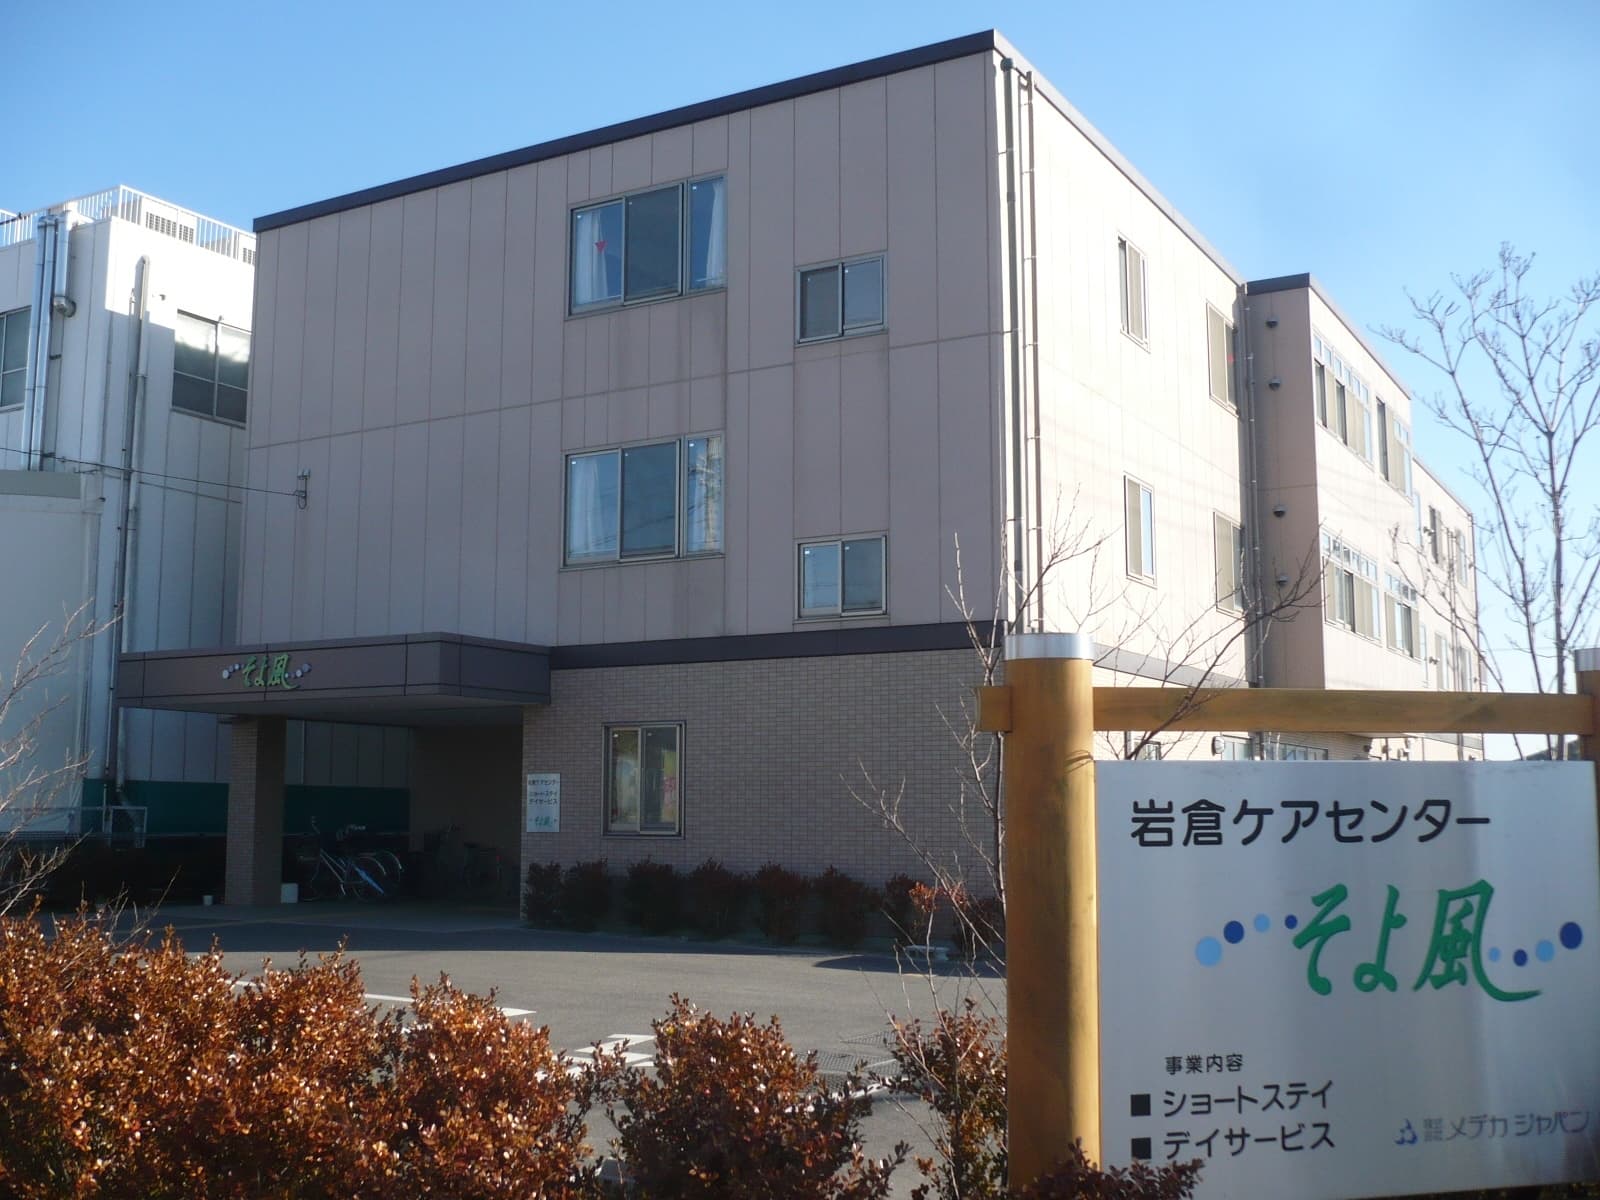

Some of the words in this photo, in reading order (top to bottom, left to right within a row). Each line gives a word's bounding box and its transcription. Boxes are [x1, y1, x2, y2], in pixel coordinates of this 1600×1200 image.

[242, 652, 301, 689] そよ風
[1131, 799, 1491, 848] 岩倉ケアセンター
[1293, 879, 1543, 1002] そよ風
[1165, 1054, 1244, 1075] 事業内容
[1163, 1080, 1333, 1117] ショートステイ
[1164, 1122, 1335, 1160] デイサービス
